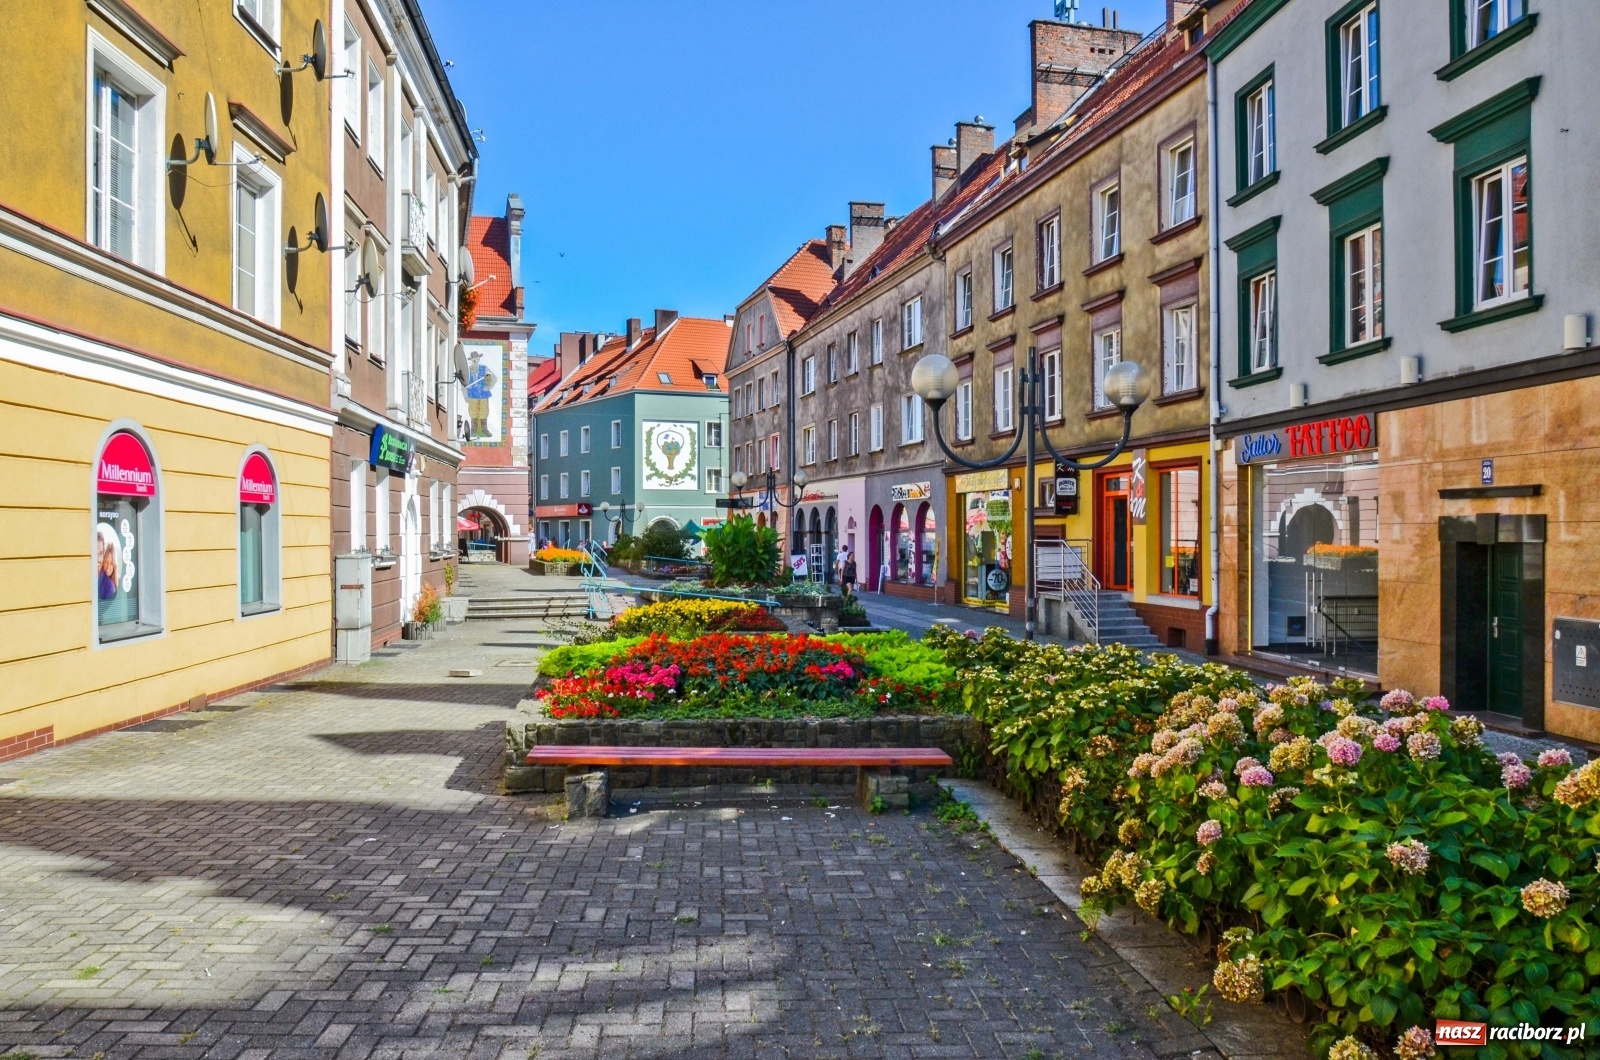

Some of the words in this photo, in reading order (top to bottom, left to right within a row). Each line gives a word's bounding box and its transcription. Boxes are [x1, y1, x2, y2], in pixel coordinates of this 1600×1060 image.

[1241, 433, 1282, 463] Sailor
[1285, 414, 1372, 458] TATTOO
[101, 459, 152, 484] Millennium
[1482, 466, 1492, 479] 20
[136, 484, 148, 492] bank
[241, 476, 273, 493] Millennium
[793, 555, 806, 570] 50%
